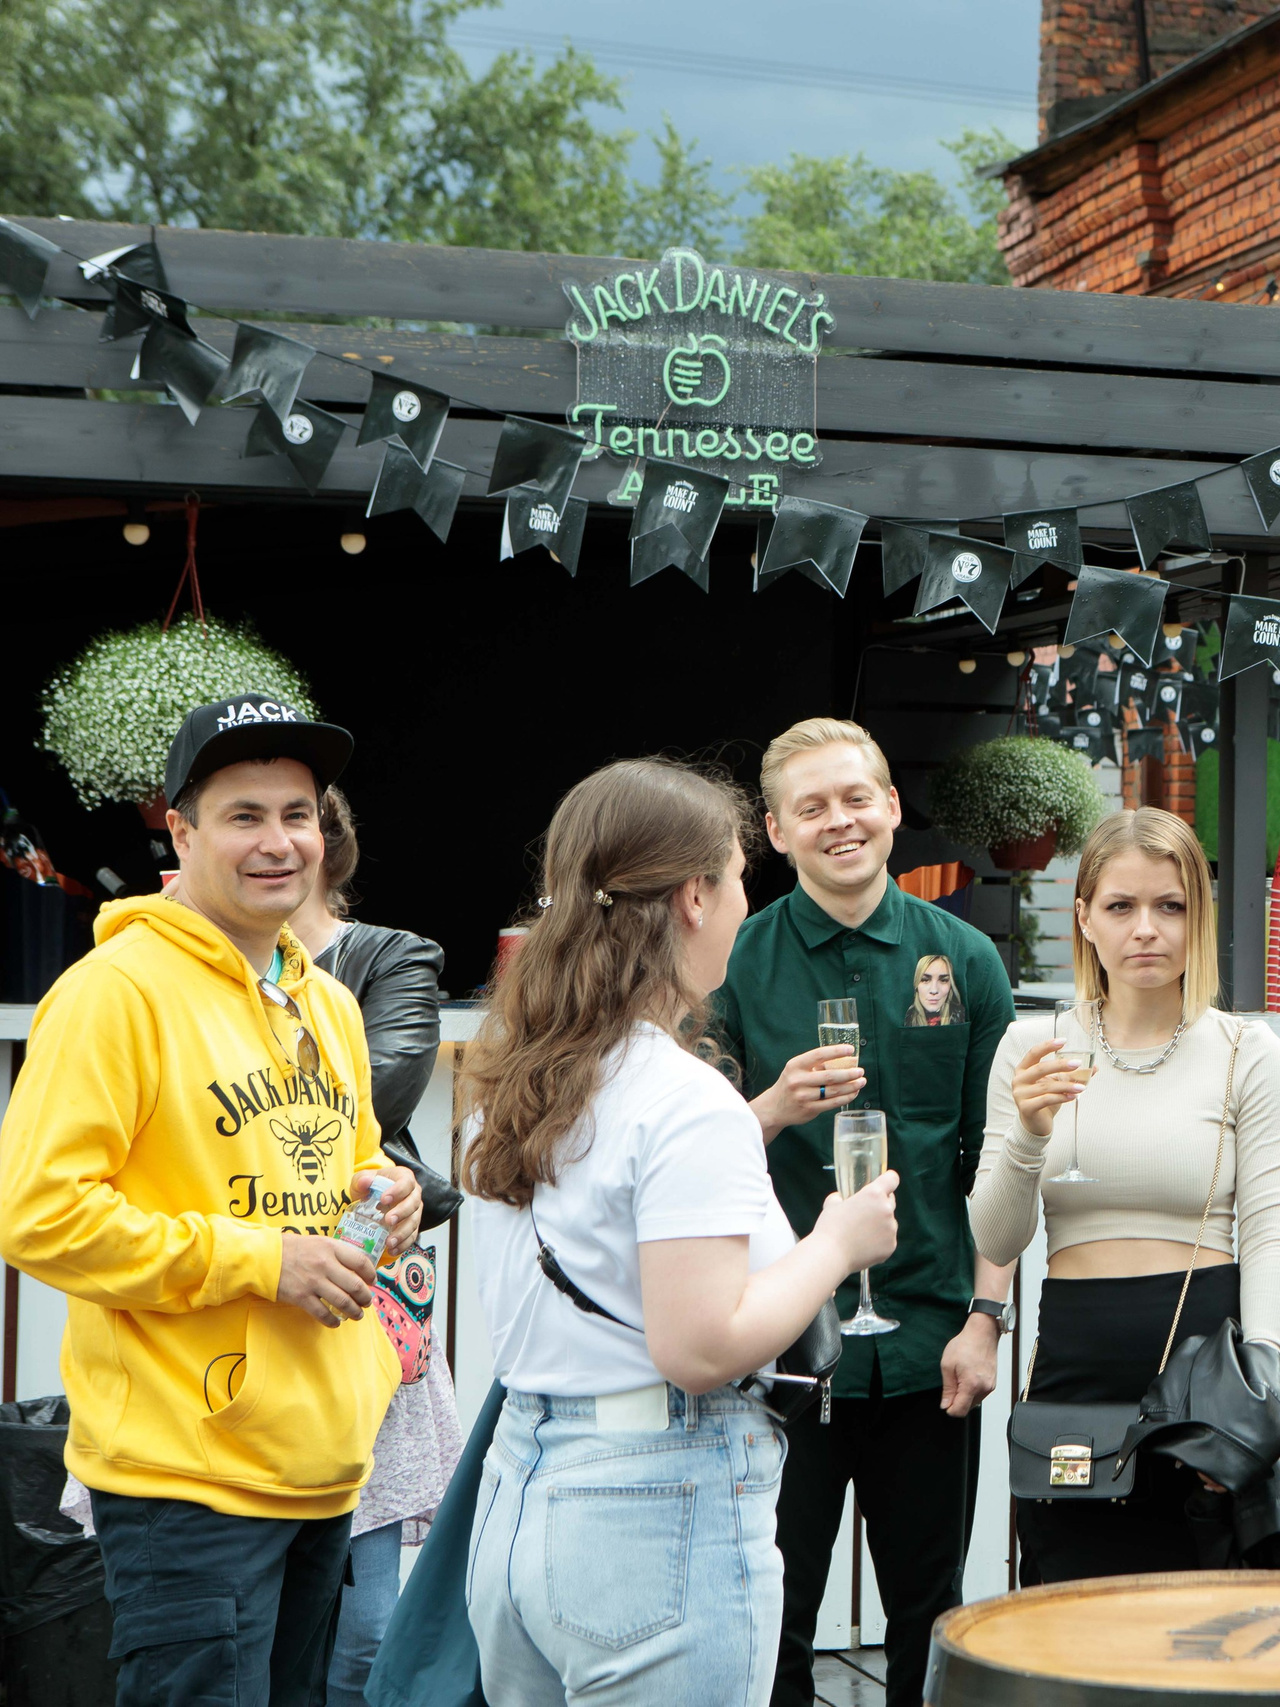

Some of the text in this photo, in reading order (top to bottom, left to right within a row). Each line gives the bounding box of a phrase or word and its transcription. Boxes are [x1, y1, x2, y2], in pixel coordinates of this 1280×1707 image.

[571, 251, 834, 352] JACK DANIEL'S
[572, 403, 816, 461] Tennessee
[666, 484, 688, 499] MAKE
[688, 491, 699, 502] IT
[663, 494, 696, 513] COUNT
[530, 507, 553, 520] MAKE
[529, 517, 560, 534] COUNT
[1027, 527, 1057, 539] MAKE IT
[1028, 535, 1058, 550] COUNT
[1255, 620, 1278, 634] MAKE
[216, 701, 297, 723] JACK
[207, 1067, 285, 1137] JACK
[228, 1174, 352, 1218] Tenness
